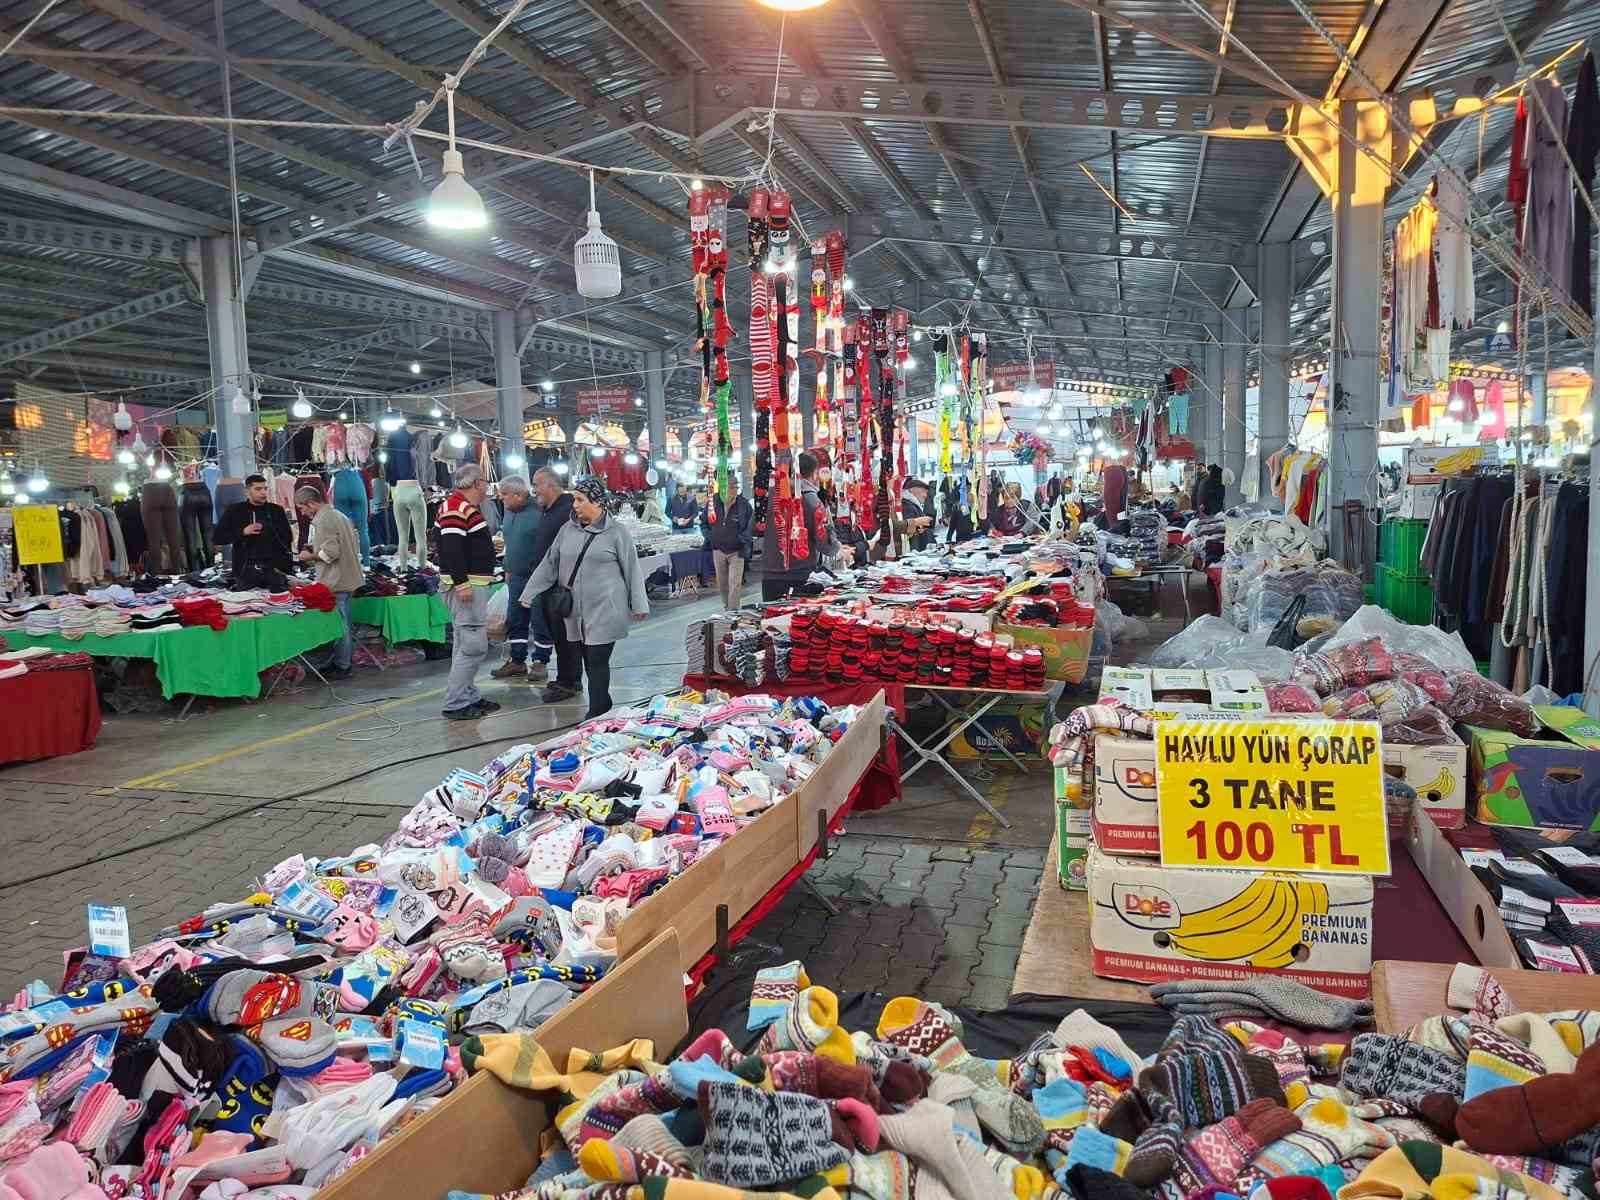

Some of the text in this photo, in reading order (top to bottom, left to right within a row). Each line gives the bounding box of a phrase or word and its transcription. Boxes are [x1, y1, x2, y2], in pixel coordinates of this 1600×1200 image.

[1165, 729, 1376, 772] HAVLU YÜN ÇORAP
[1188, 778, 1336, 811] 3 TANE
[1186, 820, 1360, 866] 100 TL
[1125, 893, 1171, 914] Dole
[1302, 914, 1367, 929] PREMIUM
[1302, 929, 1368, 945] BANANAS
[1104, 956, 1144, 969] PREMIUM
[1144, 961, 1187, 975] BANANAS
[1192, 966, 1233, 979] PREMIUM
[1325, 978, 1368, 988] BANANAS
